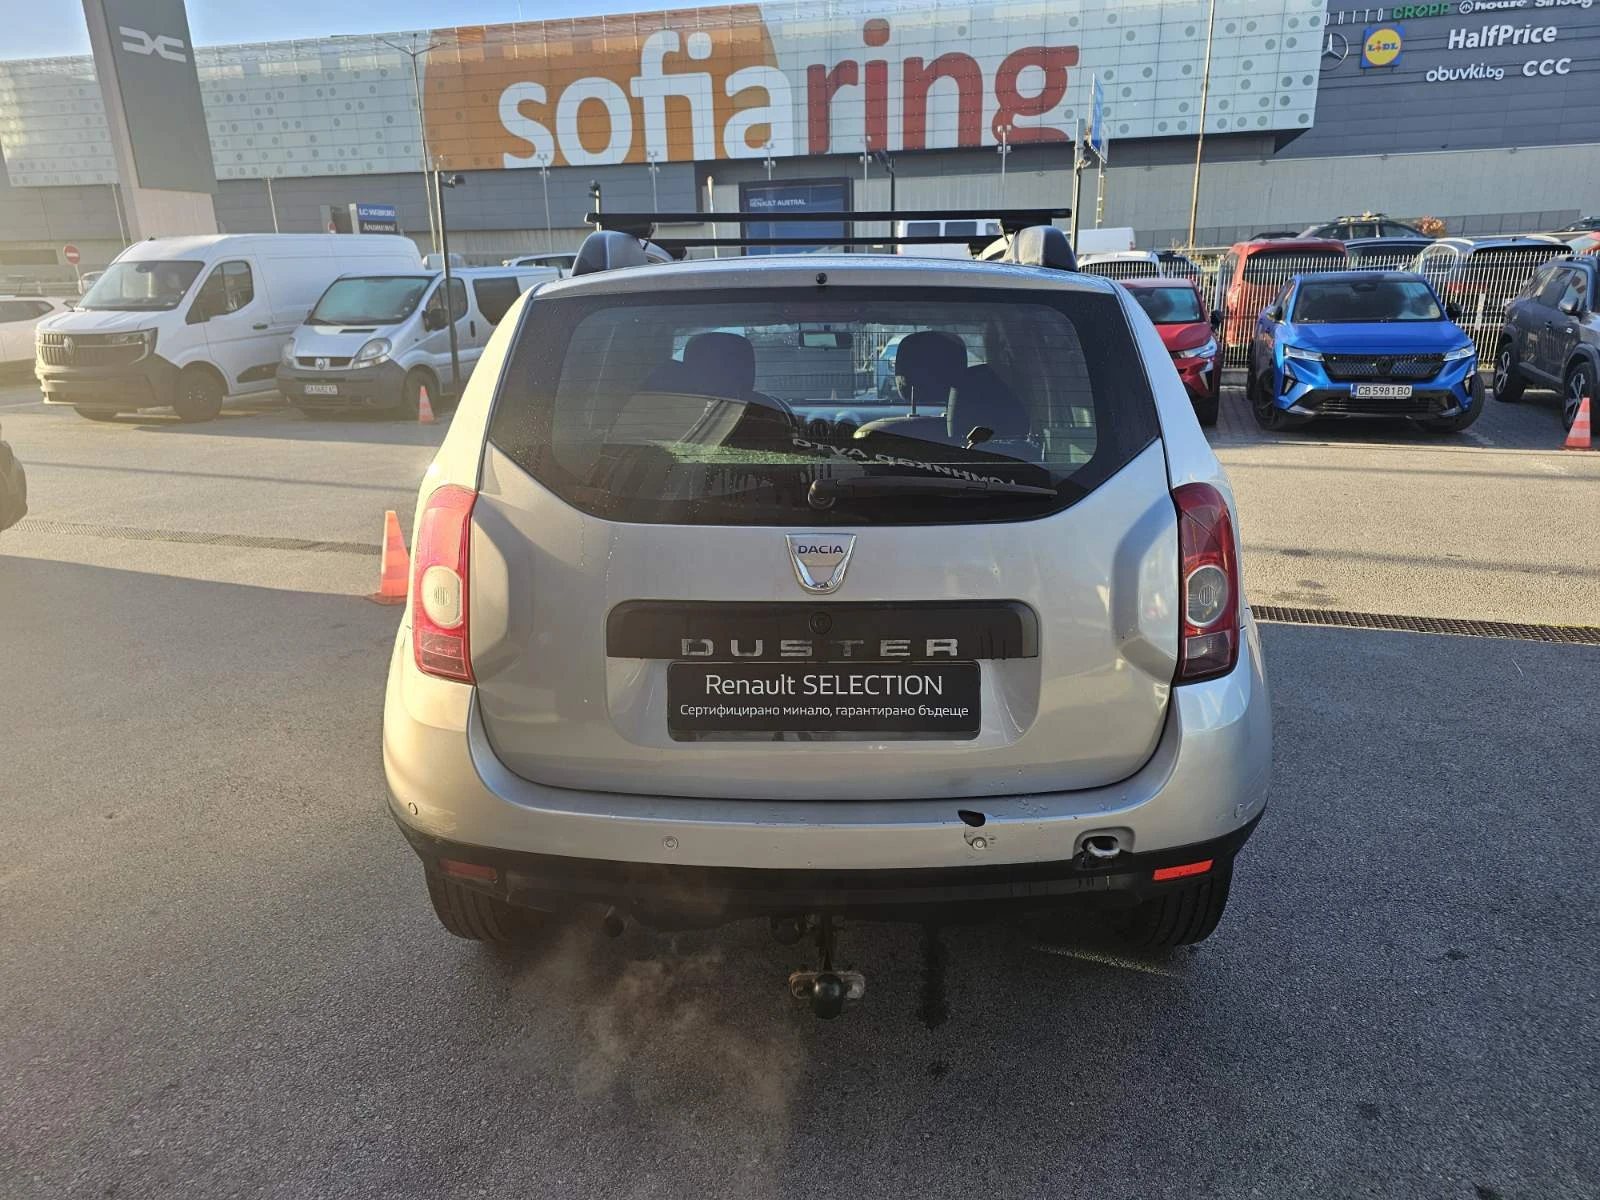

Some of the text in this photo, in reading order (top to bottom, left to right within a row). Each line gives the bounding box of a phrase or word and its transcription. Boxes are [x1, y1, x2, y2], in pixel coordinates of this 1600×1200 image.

[1392, 4, 1450, 19] CROPP
[1448, 24, 1557, 49] HalfPrice
[1426, 63, 1504, 82] obuvki.bg
[1523, 58, 1572, 76] CCC
[798, 545, 844, 554] DACIA
[681, 638, 959, 657] DUSTER
[705, 674, 943, 696] Renault SELECTION
[680, 704, 969, 718] Сертифицирано минало, гарантирано бъдеще
